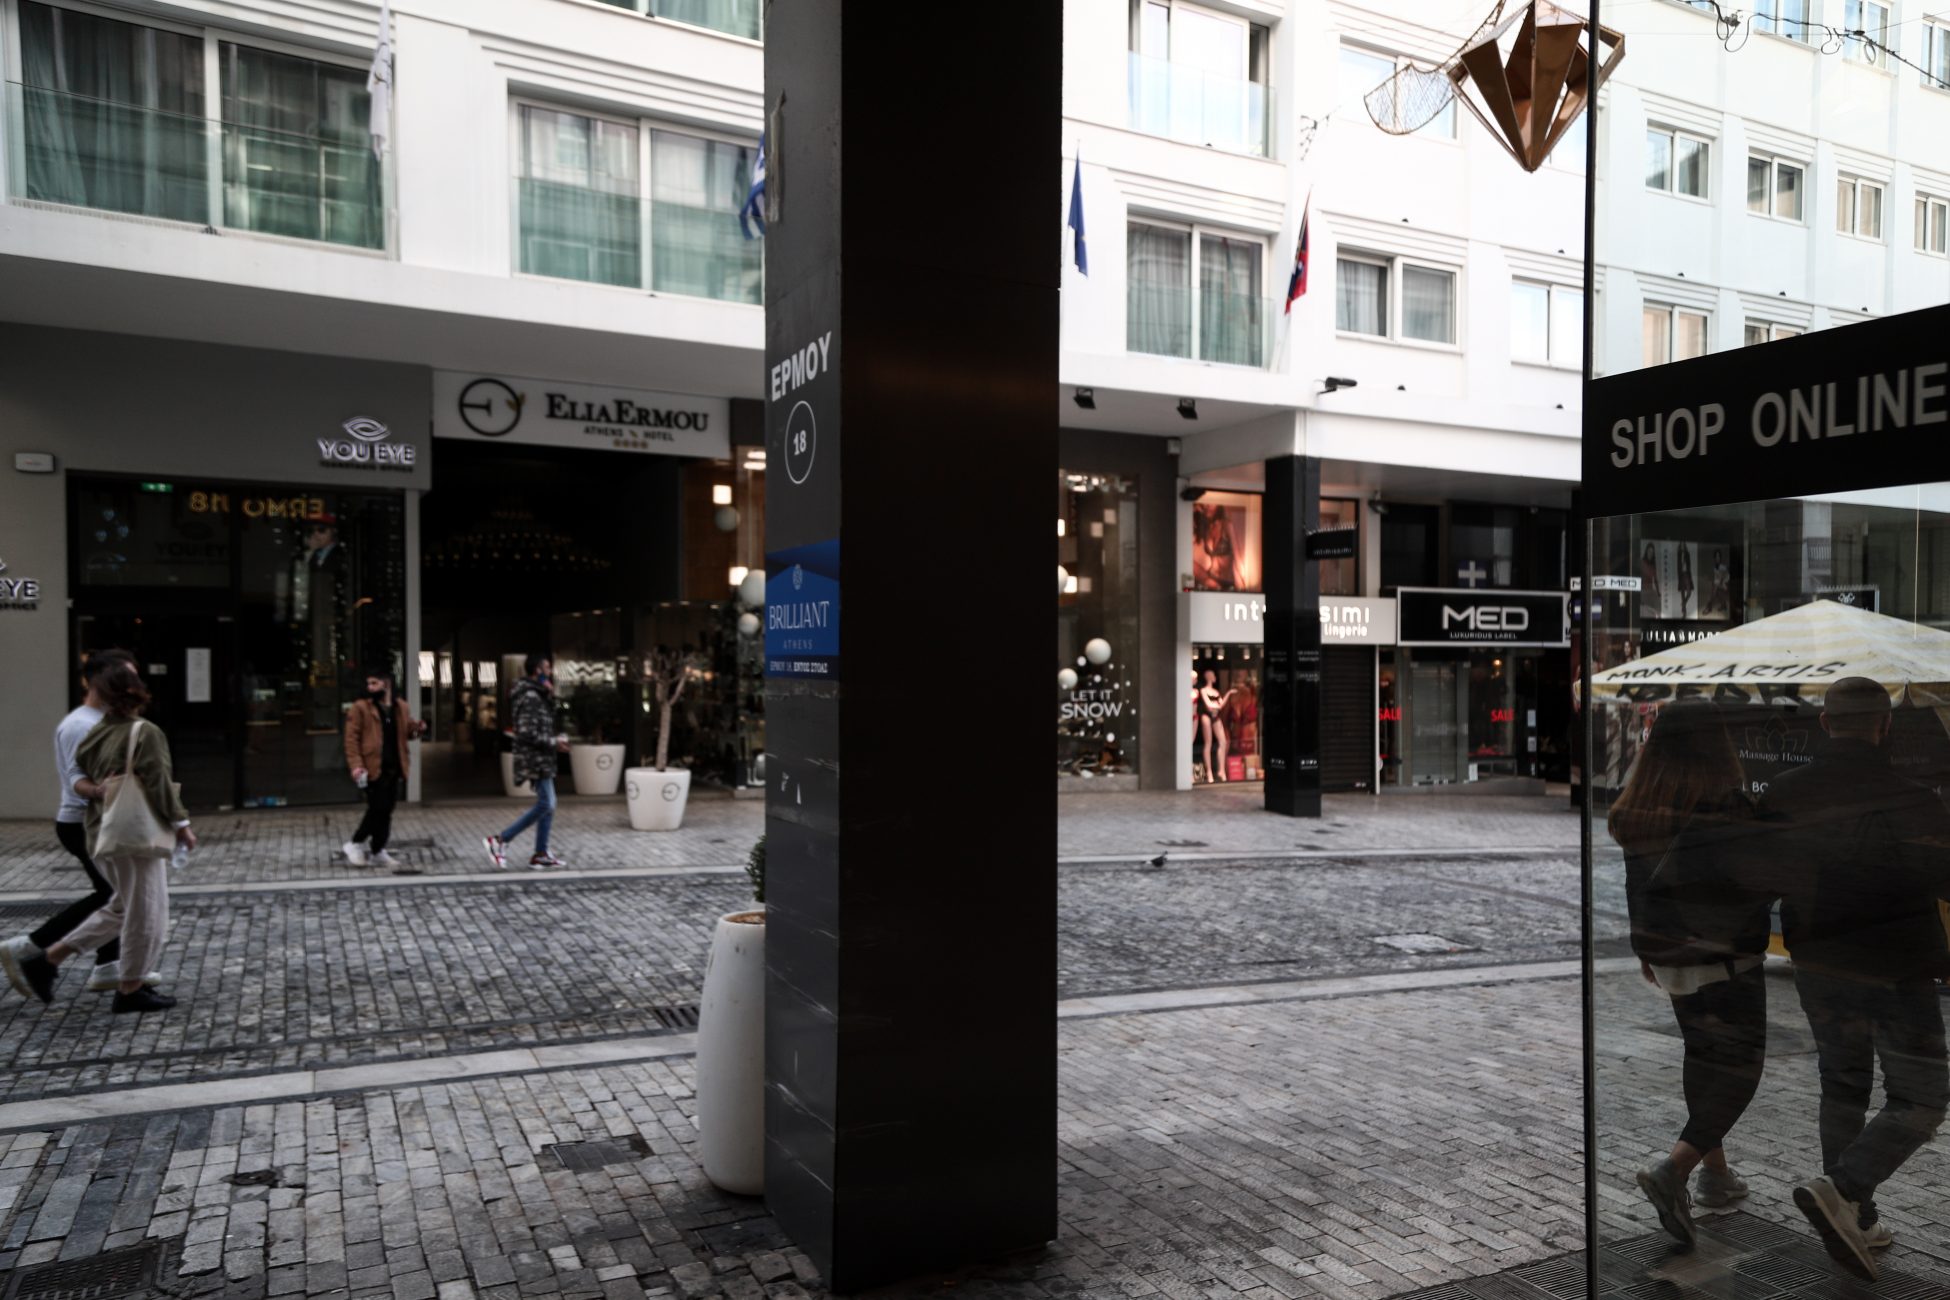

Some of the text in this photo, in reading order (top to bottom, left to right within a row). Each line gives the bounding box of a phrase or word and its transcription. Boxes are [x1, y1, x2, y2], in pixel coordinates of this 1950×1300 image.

[1610, 362, 1948, 469] SHOP ONLINE
[583, 425, 675, 442] ATHENS HOTEL
[793, 430, 807, 456] 18
[317, 439, 370, 463] YOU
[373, 442, 415, 465] EYE
[1610, 578, 1638, 589] MED
[769, 600, 830, 630] BRILLIANT
[1441, 604, 1529, 631] MED
[1323, 623, 1368, 639] lingerie
[1449, 631, 1518, 640] LUXURIOUS LABEL
[783, 639, 813, 650] ATHENS
[1070, 689, 1113, 702] LET IT
[1061, 702, 1123, 719] SNOW
[1379, 707, 1402, 721] SALE
[1490, 708, 1515, 723] SALE
[1739, 748, 1814, 763] Massage House
